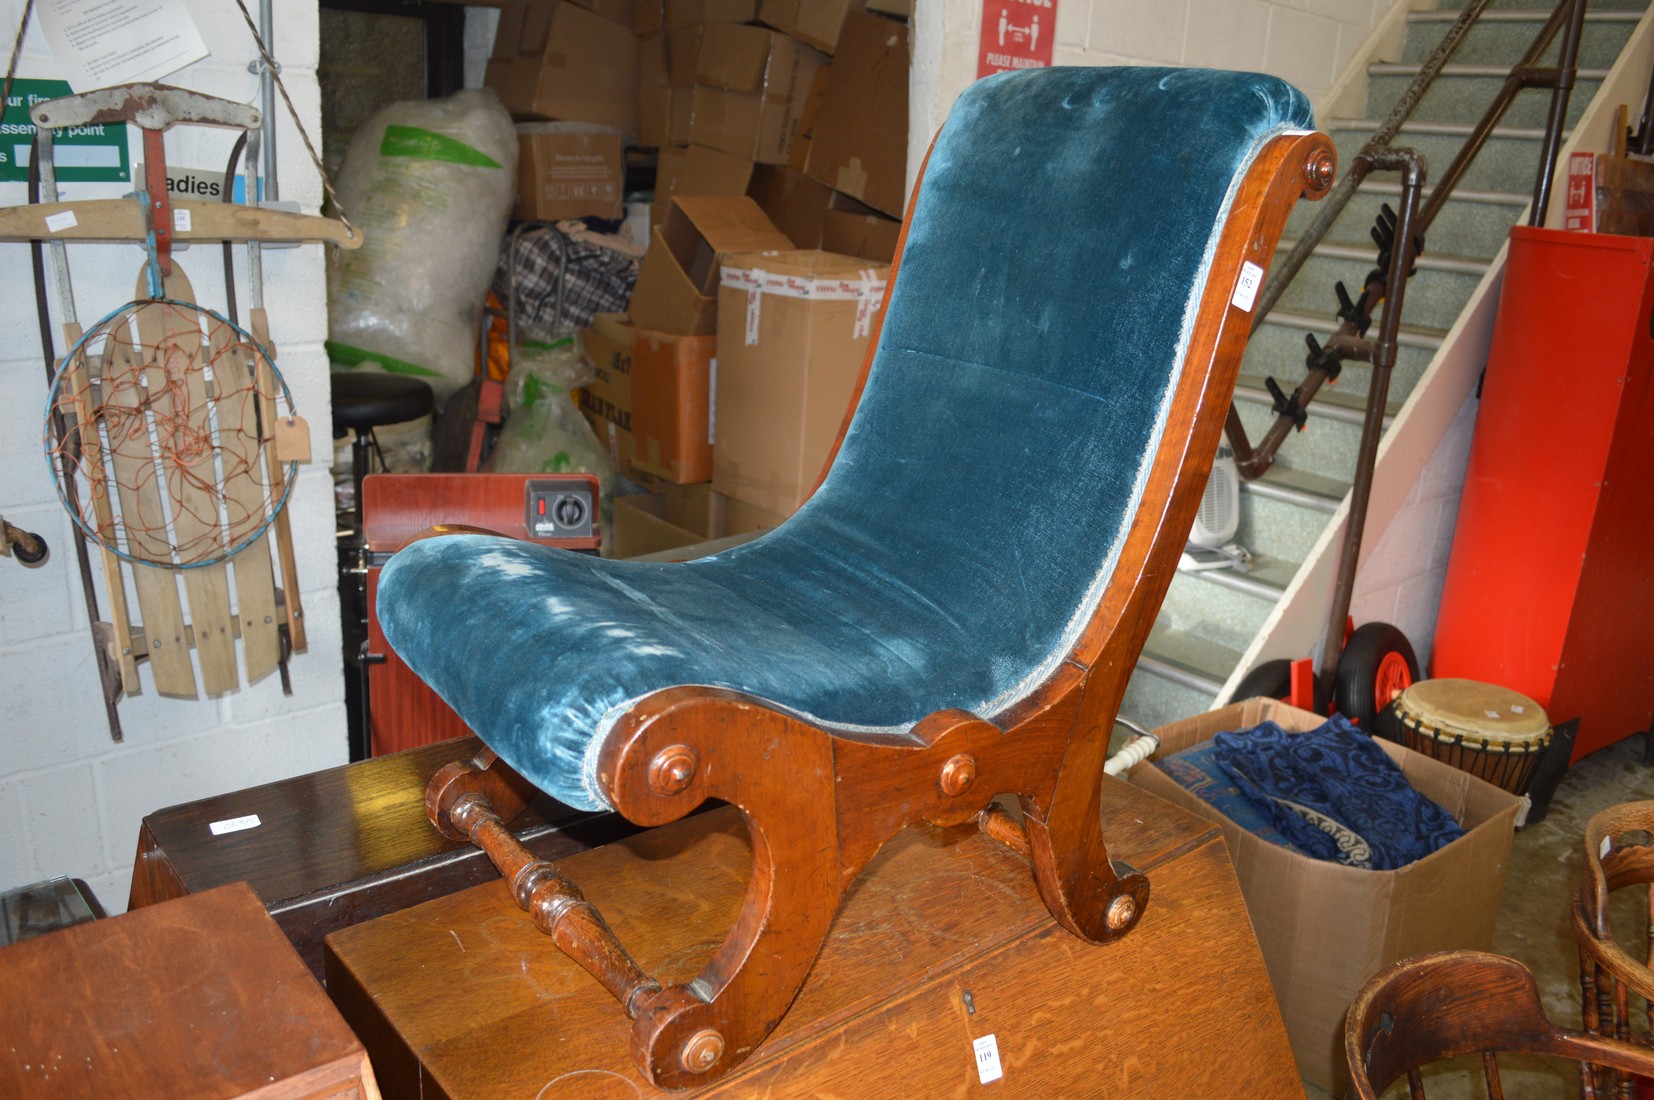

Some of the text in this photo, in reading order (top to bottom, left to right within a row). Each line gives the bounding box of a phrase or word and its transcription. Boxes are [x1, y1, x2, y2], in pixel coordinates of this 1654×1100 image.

[986, 52, 1012, 68] PLEASE
[68, 124, 105, 138] point
[166, 175, 220, 196] adies
[1241, 276, 1253, 289] 152
[979, 1050, 992, 1063] 119
